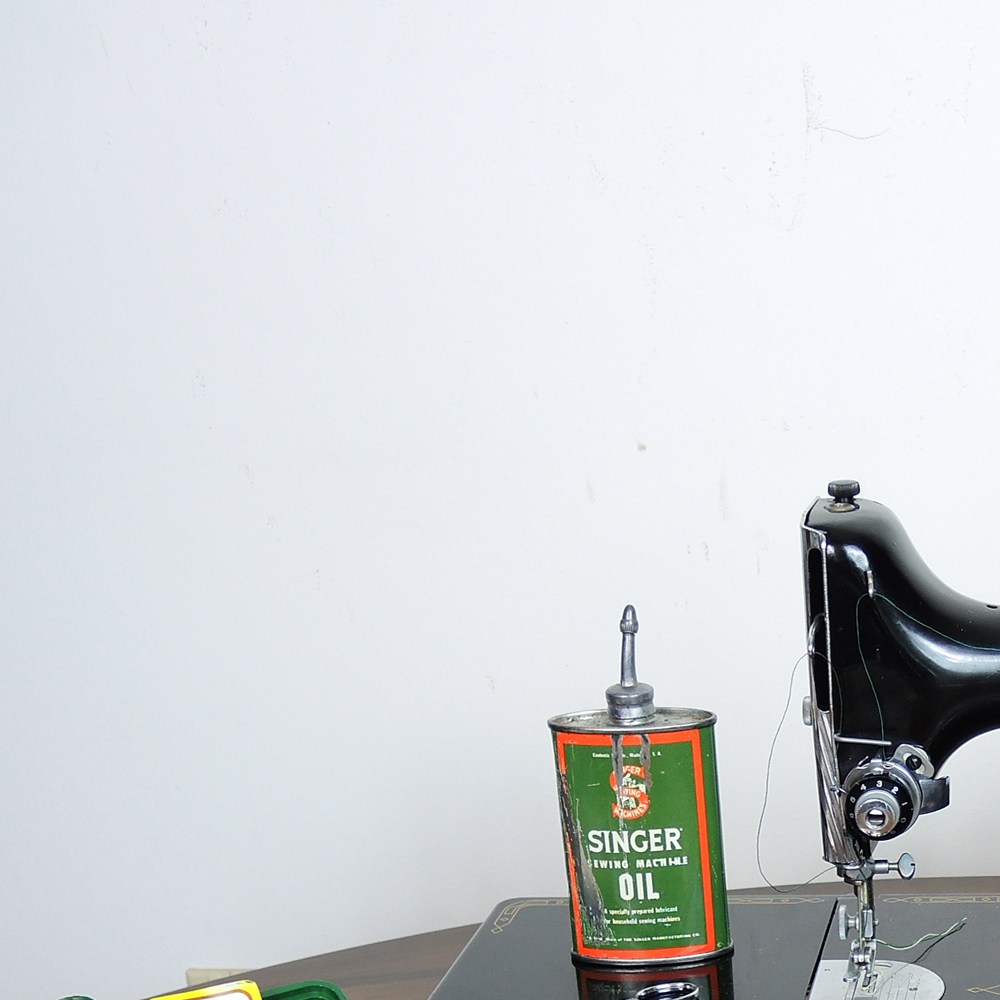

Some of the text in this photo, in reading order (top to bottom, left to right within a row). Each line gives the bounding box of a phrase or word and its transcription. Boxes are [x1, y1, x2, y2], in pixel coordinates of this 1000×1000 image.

[876, 780, 883, 788] 3
[891, 786, 899, 794] 2
[587, 827, 683, 854] SINGER
[636, 856, 689, 869] MACHINE
[618, 872, 661, 901] OIL
